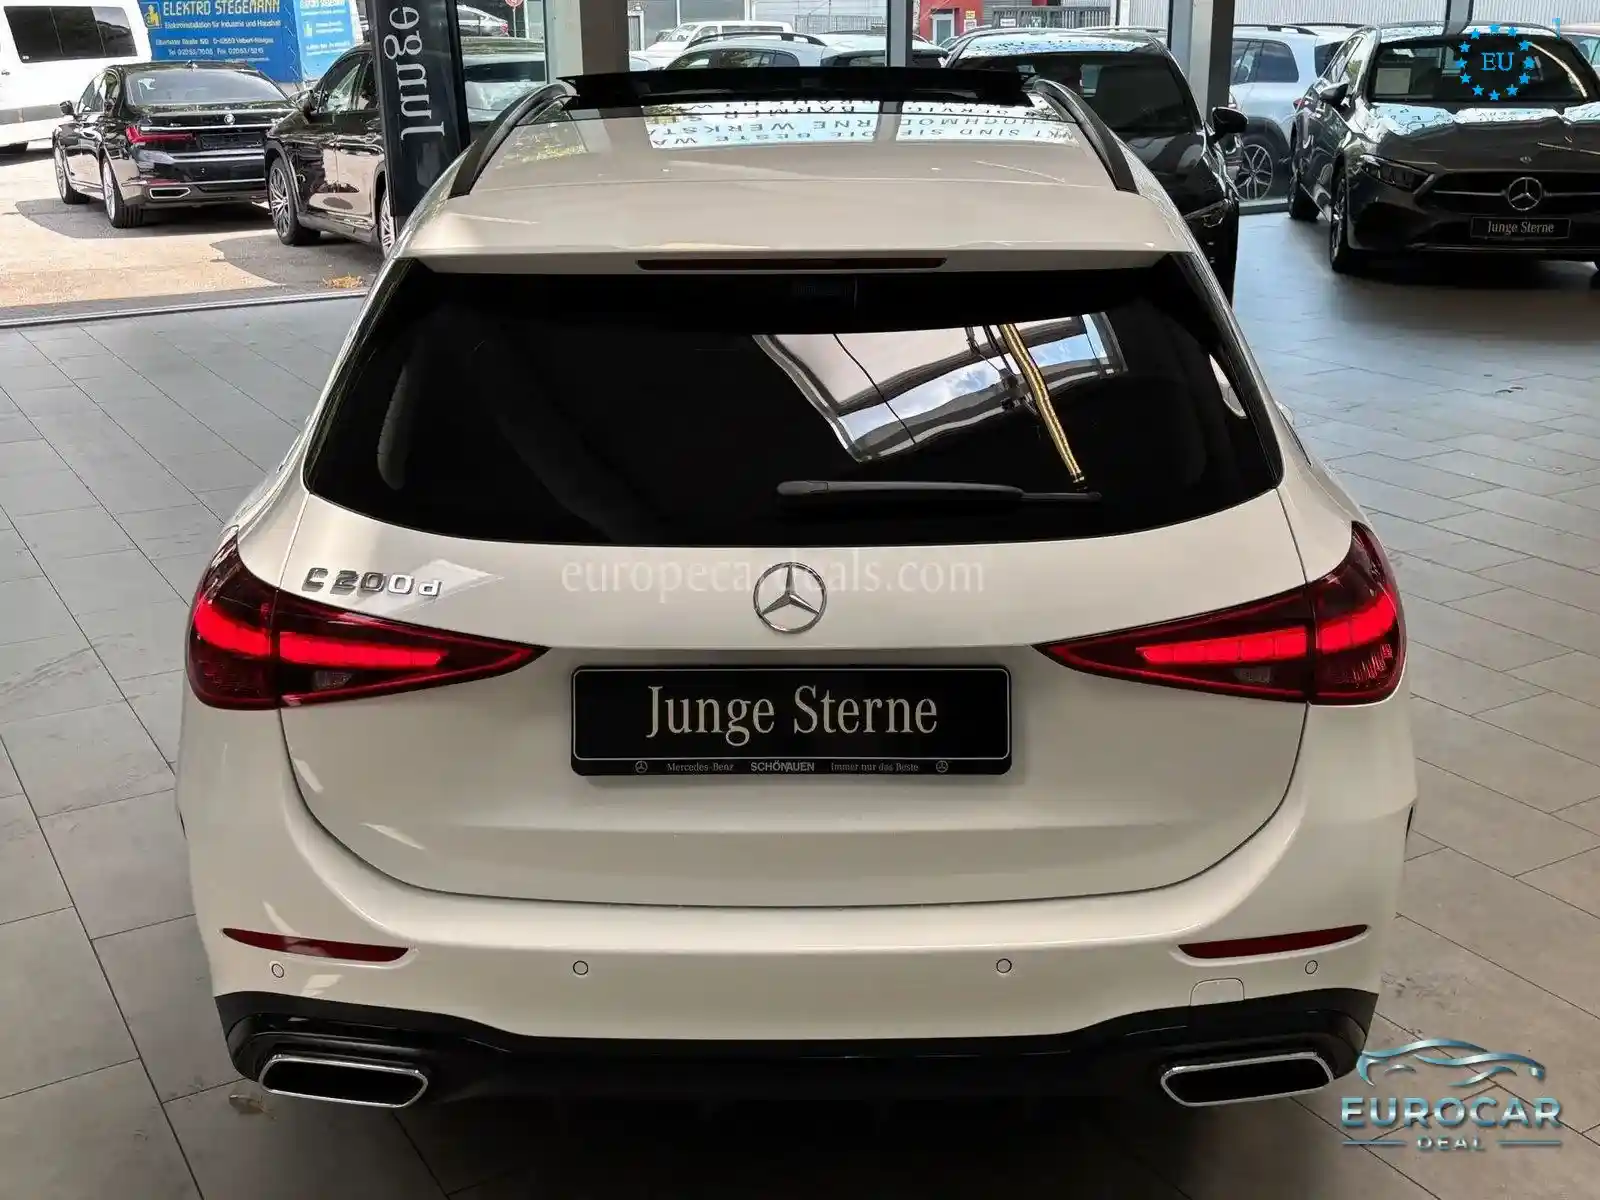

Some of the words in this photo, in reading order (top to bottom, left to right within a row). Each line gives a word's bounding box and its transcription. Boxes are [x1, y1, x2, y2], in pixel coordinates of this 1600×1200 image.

[163, 1, 211, 16] ELEKTRO
[215, 0, 280, 15] STEGEMANN
[383, 6, 445, 140] Junge
[1488, 220, 1518, 236] Junge
[1520, 221, 1555, 234] Sterne
[646, 685, 776, 747] Junge
[793, 685, 938, 735] Sterne
[667, 762, 734, 773] Mercedes-Benz
[861, 763, 877, 772] nur
[879, 762, 893, 772] das
[895, 762, 919, 772] Beste
